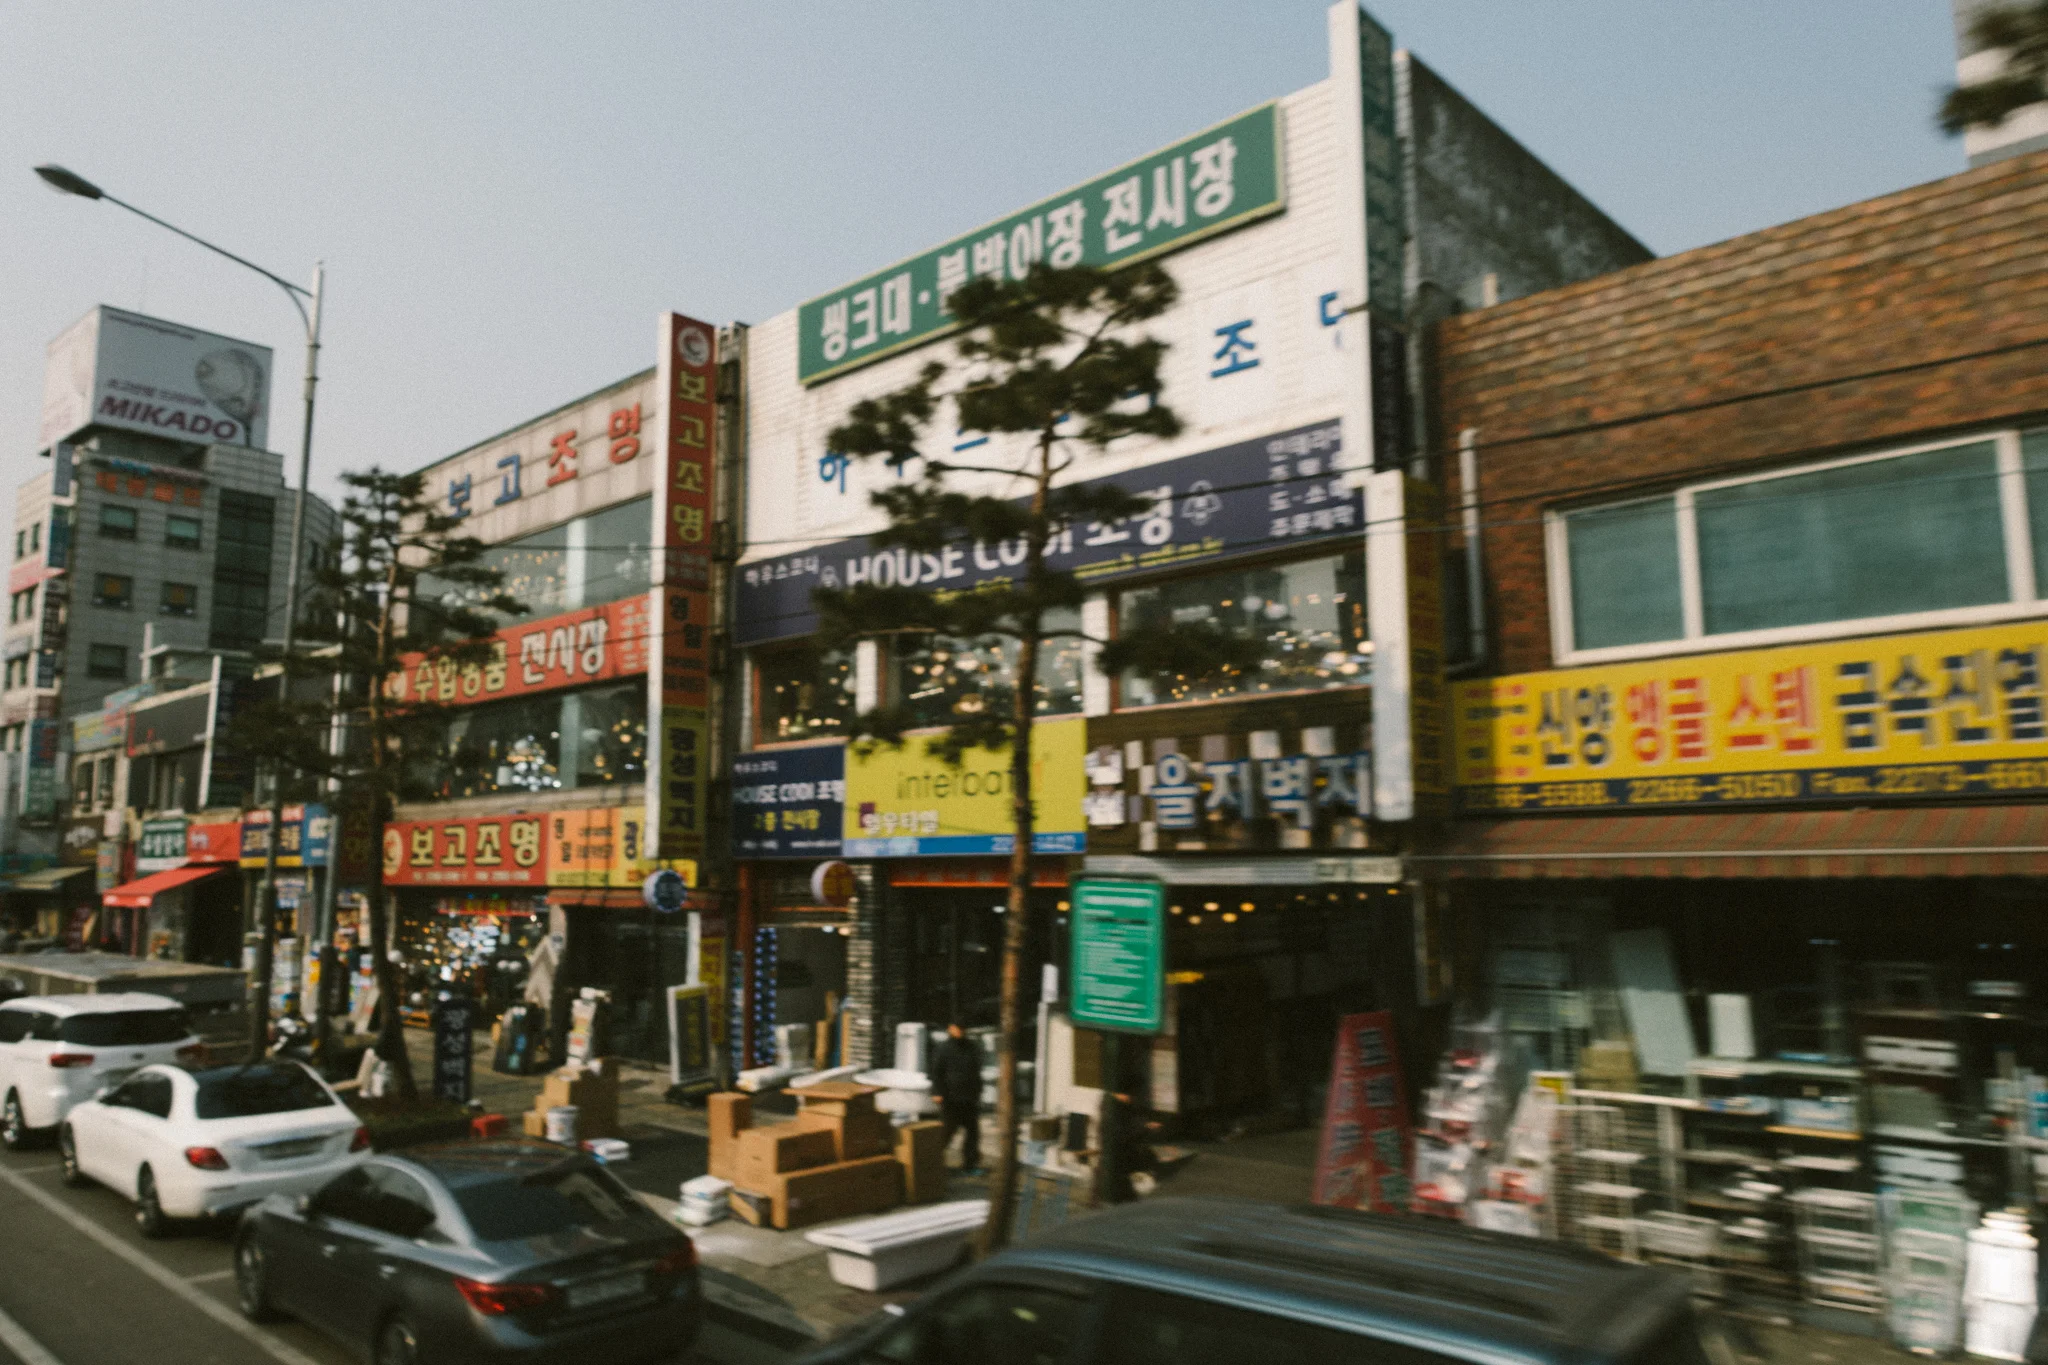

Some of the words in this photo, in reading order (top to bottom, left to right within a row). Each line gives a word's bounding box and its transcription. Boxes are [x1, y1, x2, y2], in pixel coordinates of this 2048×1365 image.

[1102, 136, 1238, 253] 전시장
[99, 395, 239, 441] MIKADO
[673, 370, 707, 542] 보고조명
[448, 402, 641, 520] 보고조명
[847, 545, 965, 588] HOUSE
[520, 616, 609, 685] 전시장
[1625, 677, 1711, 767] 앵글
[408, 818, 542, 868] 보고조명
